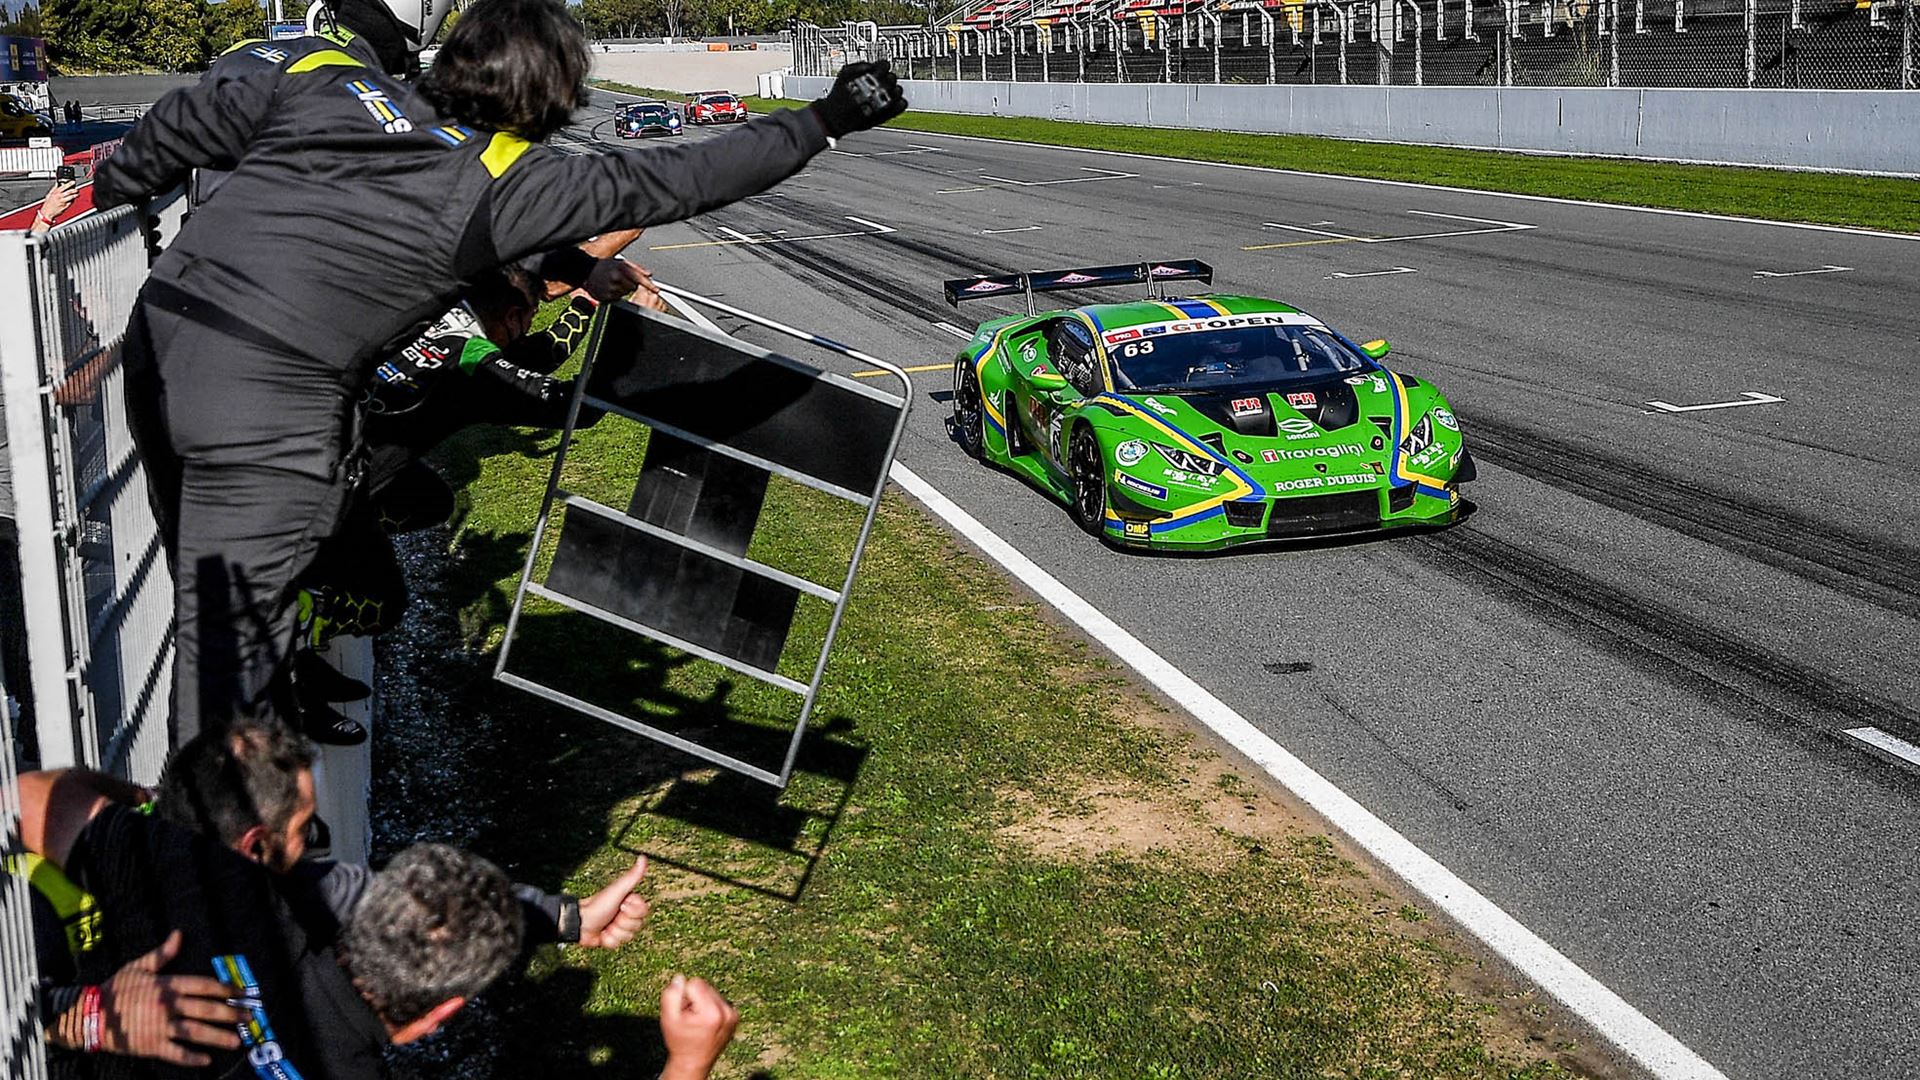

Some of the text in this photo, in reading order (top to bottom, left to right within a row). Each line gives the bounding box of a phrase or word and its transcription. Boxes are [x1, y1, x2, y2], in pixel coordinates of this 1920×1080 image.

[1115, 332, 1132, 340] PRO
[1124, 340, 1154, 358] 63
[1231, 397, 1262, 411] PR
[1287, 392, 1317, 406] PR
[1274, 473, 1377, 492] ROGER DUBUIS
[1125, 523, 1149, 533] OMP
